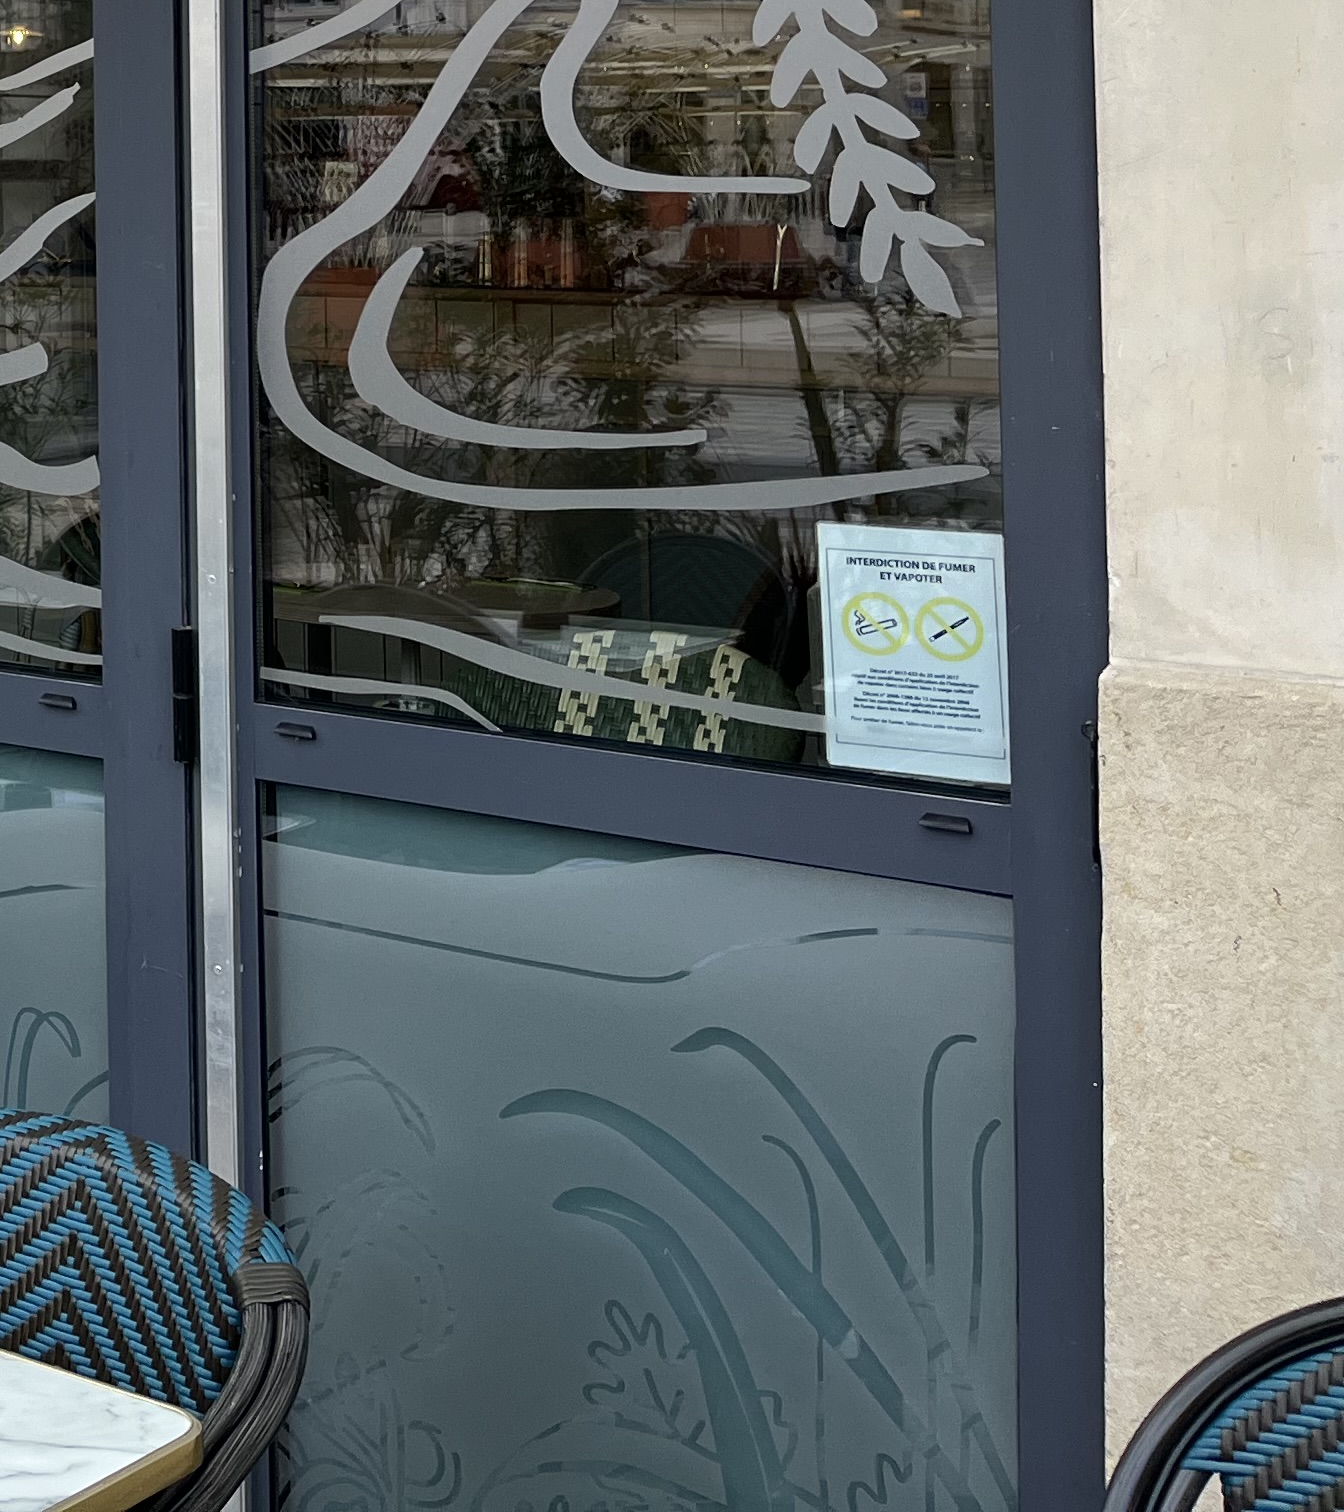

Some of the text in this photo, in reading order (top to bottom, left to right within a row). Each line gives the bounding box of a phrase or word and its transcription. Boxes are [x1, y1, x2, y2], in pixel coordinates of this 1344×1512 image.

[846, 557, 976, 573] INTERDICTION DE FUMER
[880, 572, 942, 584] ET VAPOTER
